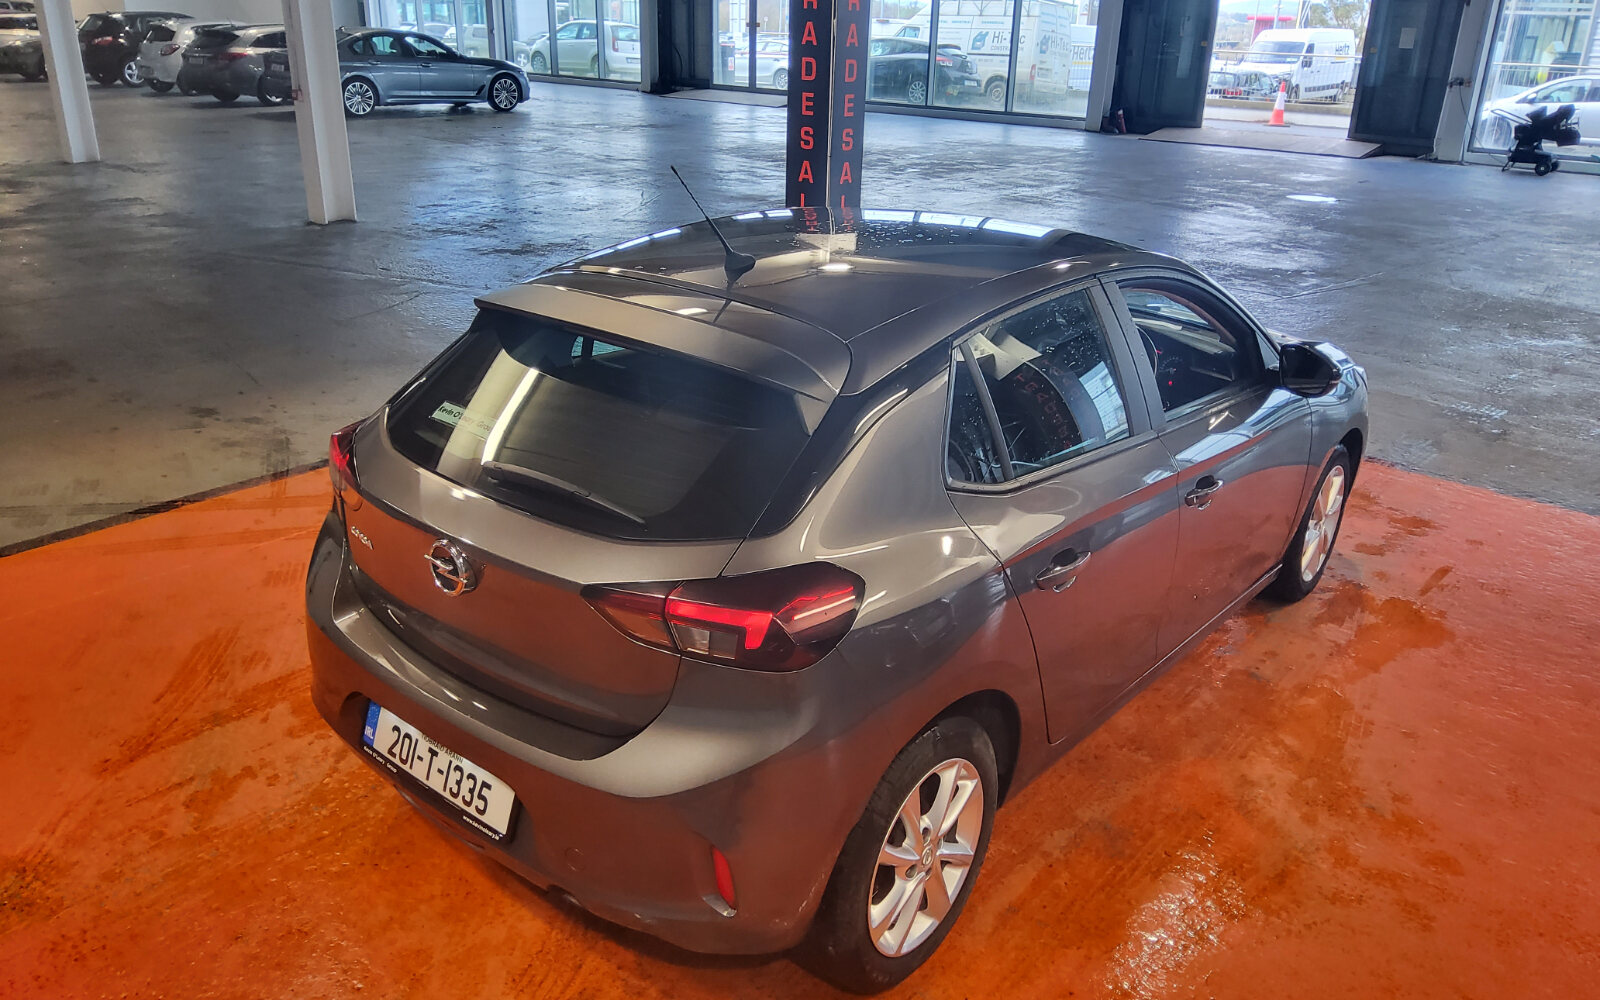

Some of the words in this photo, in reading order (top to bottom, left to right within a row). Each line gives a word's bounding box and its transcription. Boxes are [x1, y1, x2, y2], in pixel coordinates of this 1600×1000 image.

[992, 31, 1026, 44] Hi-c
[1072, 46, 1094, 60] Hert
[438, 405, 454, 416] Kevin
[364, 725, 374, 740] IRL
[387, 725, 492, 816] 201-T-1335
